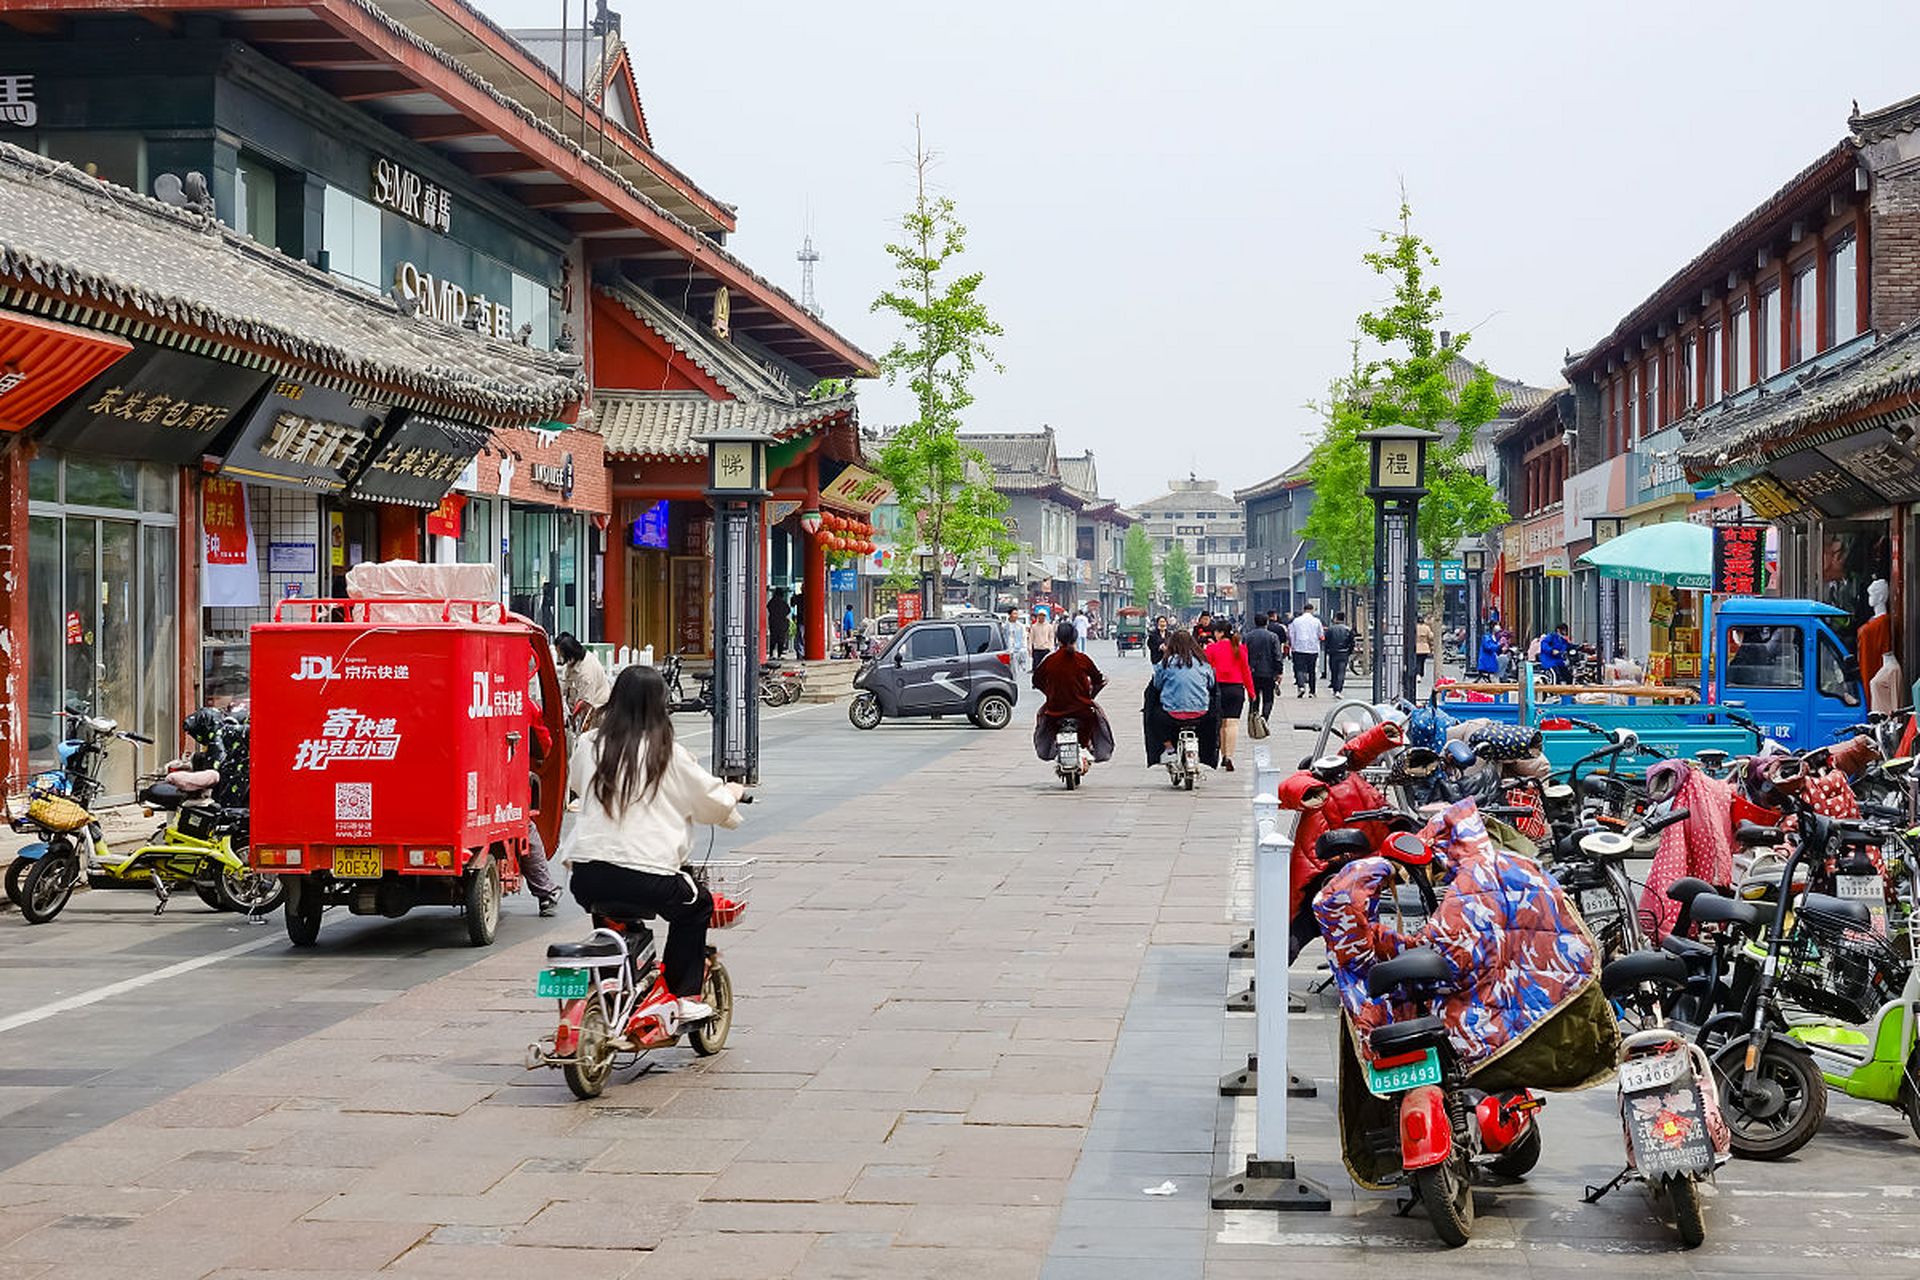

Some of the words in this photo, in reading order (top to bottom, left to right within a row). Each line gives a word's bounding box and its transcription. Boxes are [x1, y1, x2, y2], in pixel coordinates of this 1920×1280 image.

[290, 655, 342, 681] JDL
[345, 665, 409, 680] 京东快递
[468, 671, 493, 719] JDL
[322, 707, 397, 739] 寄快递
[292, 739, 400, 770] 找京东小哥
[337, 860, 379, 875] 20E32
[1375, 1066, 1436, 1089] 0562493
